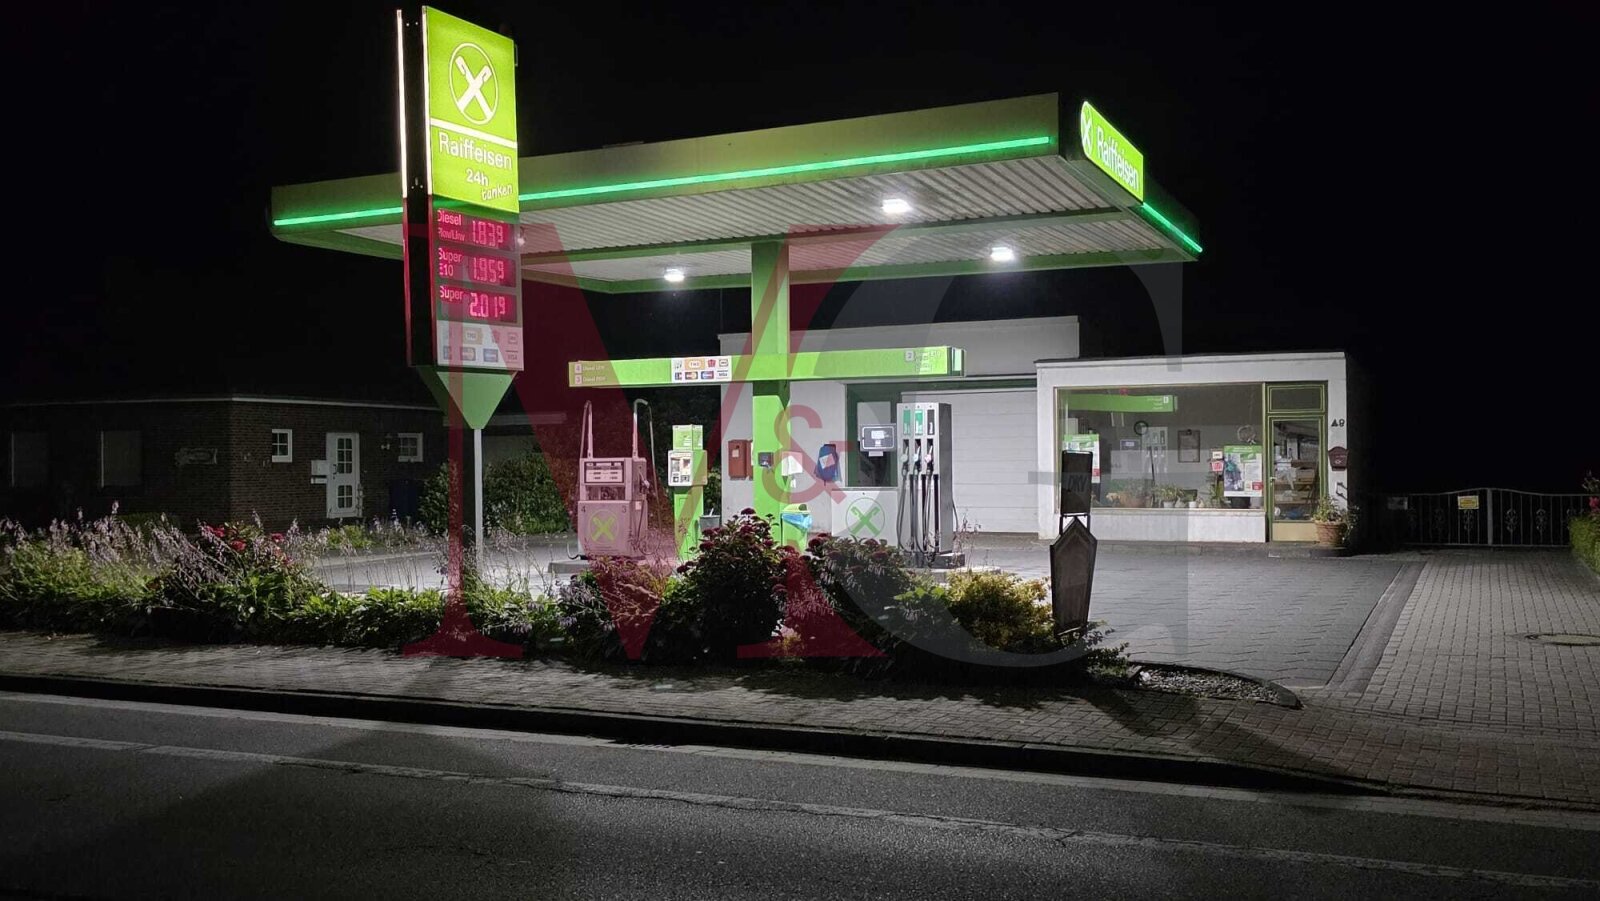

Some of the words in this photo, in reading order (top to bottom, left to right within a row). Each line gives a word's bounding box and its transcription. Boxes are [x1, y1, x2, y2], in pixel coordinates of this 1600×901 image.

[438, 132, 512, 171] Raiffeisen
[1096, 126, 1138, 190] Raiffeisen
[465, 169, 489, 187] 24h
[481, 184, 513, 201] tanken
[437, 210, 462, 226] Diesel
[438, 247, 462, 263] Super
[440, 285, 463, 301] Super
